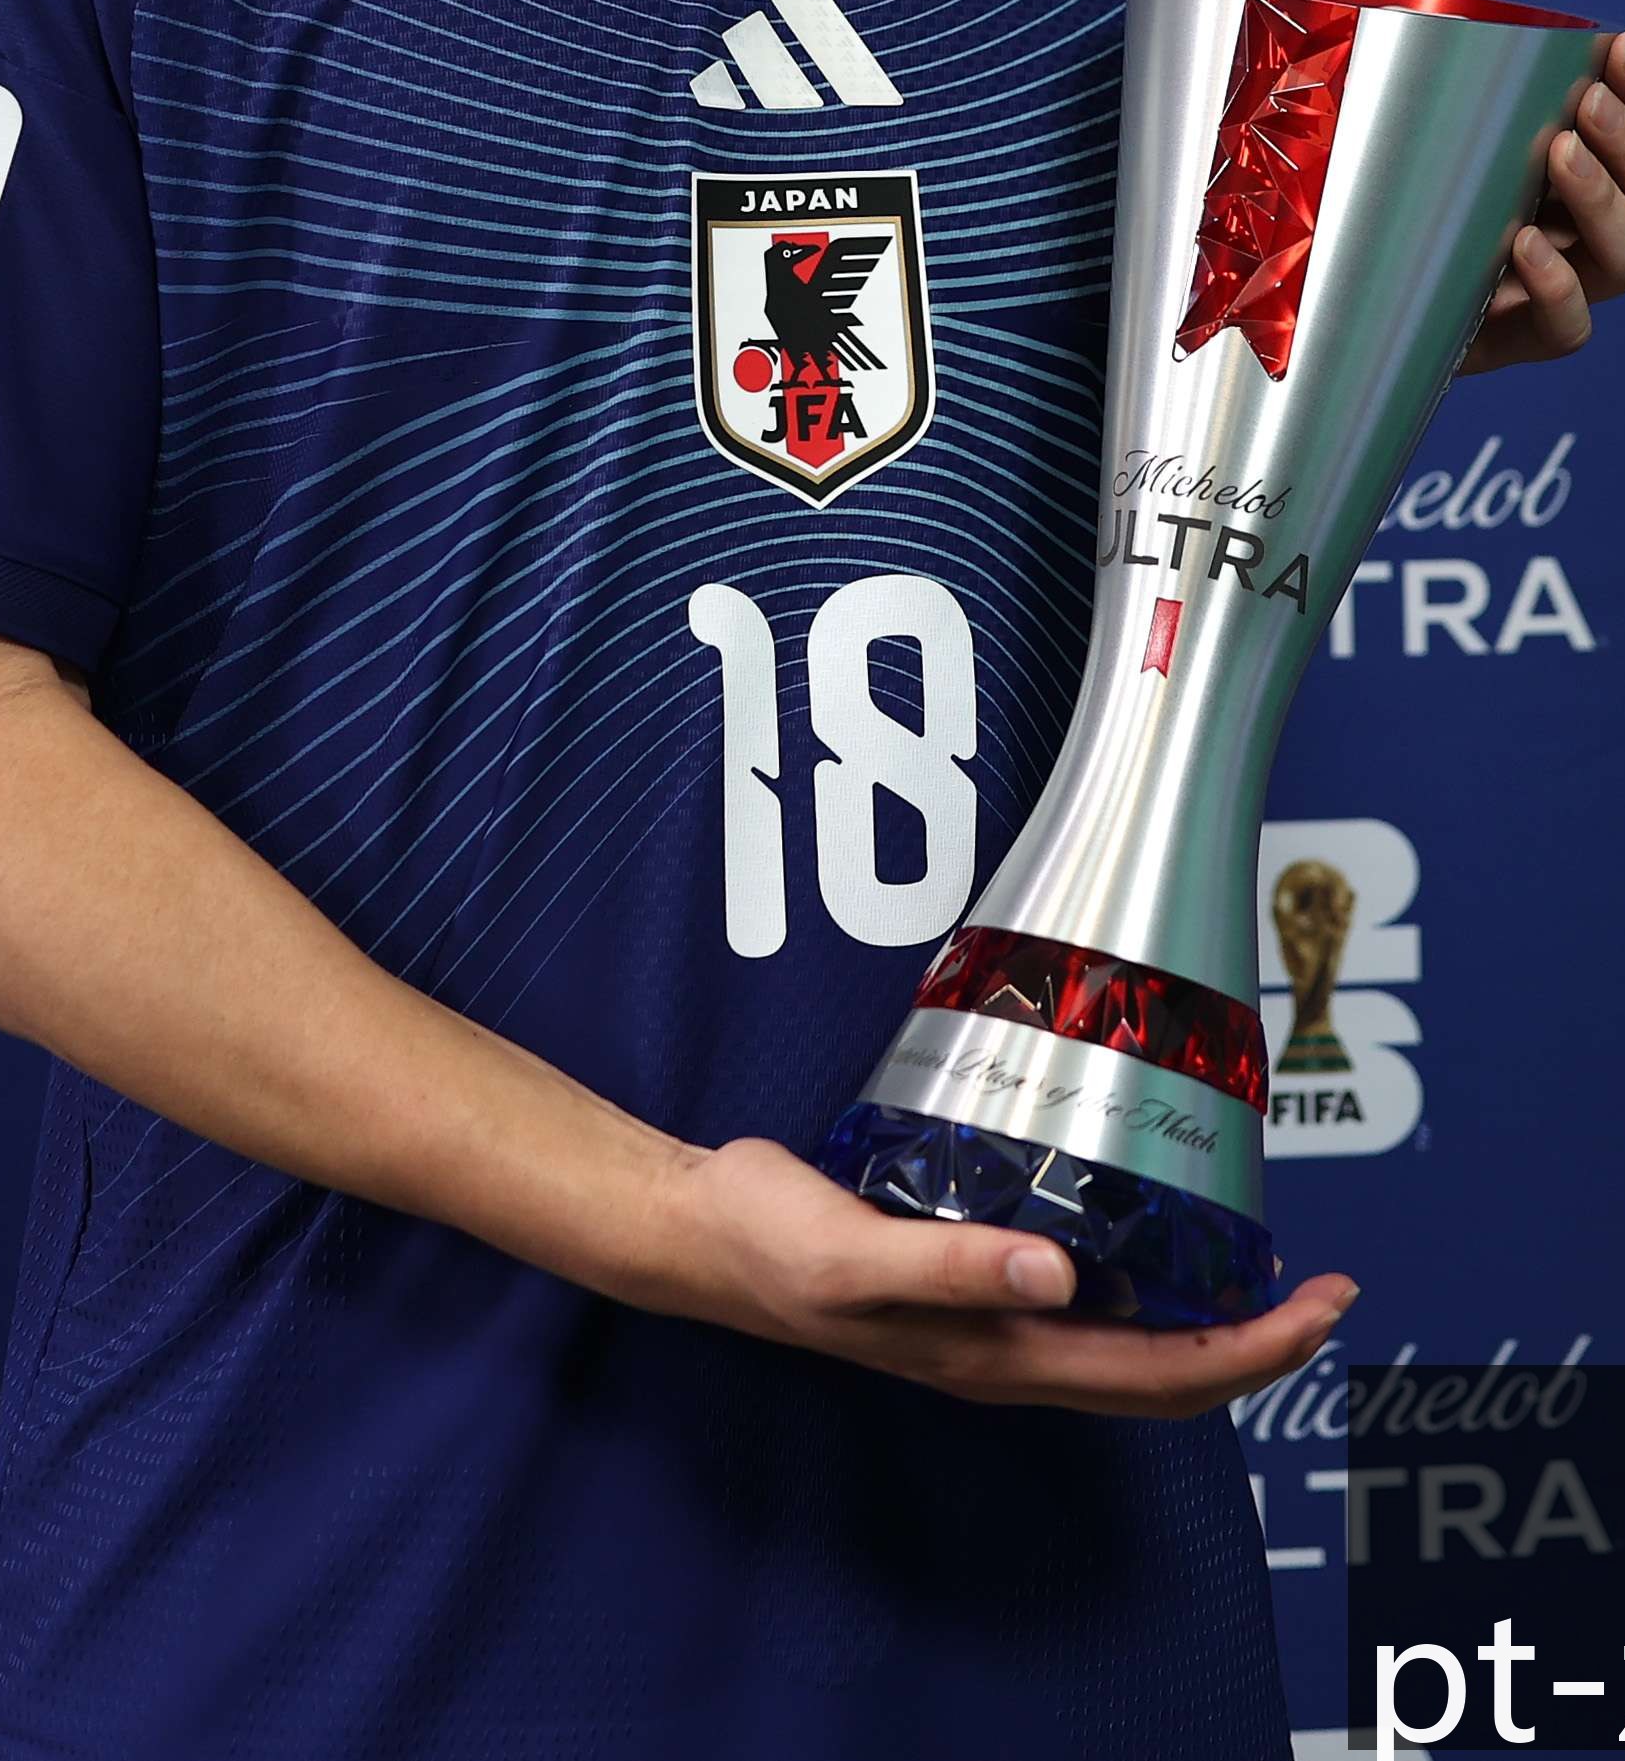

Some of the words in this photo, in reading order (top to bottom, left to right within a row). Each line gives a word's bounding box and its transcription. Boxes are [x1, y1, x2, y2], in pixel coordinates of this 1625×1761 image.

[740, 187, 858, 213] JAPAN
[761, 392, 868, 443] JFA
[1113, 449, 1293, 520] Michelob
[688, 574, 977, 959] 18
[1125, 1098, 1219, 1154] Match
[1270, 1090, 1362, 1126] FIFA
